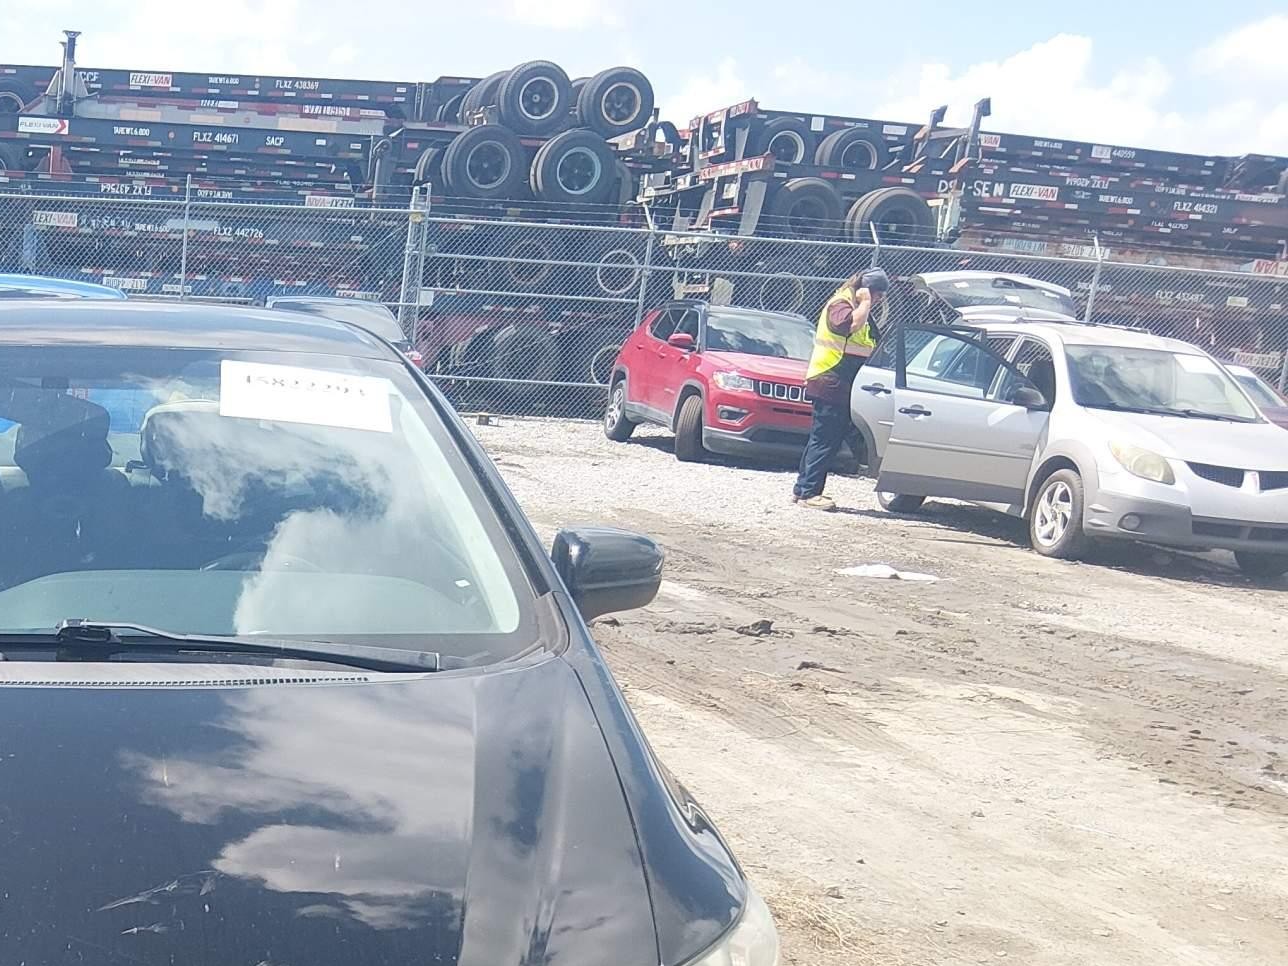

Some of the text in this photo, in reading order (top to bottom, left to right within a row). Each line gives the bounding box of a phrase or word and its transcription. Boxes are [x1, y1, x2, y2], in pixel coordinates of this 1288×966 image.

[130, 73, 171, 86] FLEXI-VAN
[275, 79, 292, 89] FLXZ
[193, 131, 239, 144] FLXZ 414671
[265, 136, 285, 147] SACP
[133, 185, 152, 196] FLXZ
[1011, 184, 1057, 200] FLEXI-VAN
[1173, 201, 1192, 212] FLXZ
[213, 226, 264, 239] FLXZ 442726
